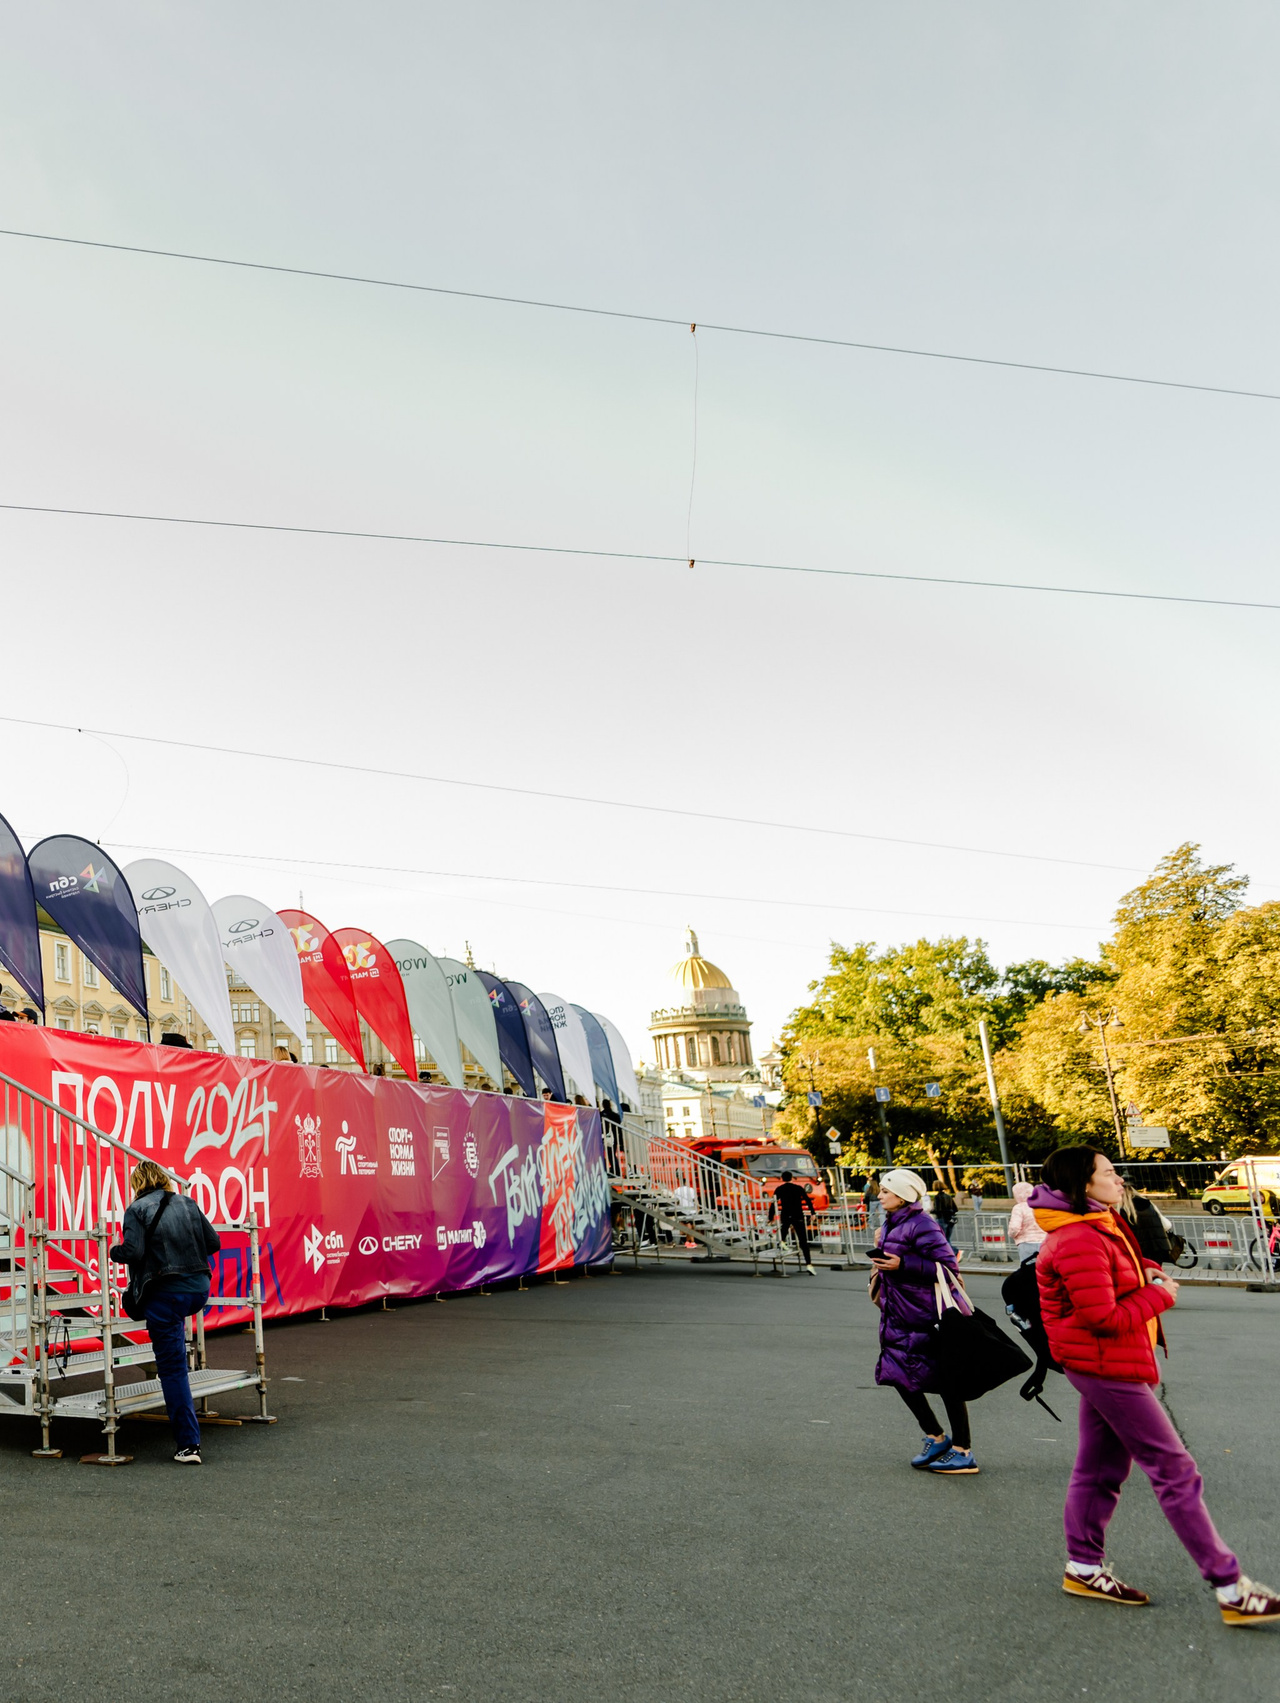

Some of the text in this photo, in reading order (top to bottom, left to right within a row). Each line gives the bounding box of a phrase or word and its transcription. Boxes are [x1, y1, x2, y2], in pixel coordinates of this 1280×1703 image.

[52, 1070, 278, 1165] ПОЛУ 2024
[388, 1127, 408, 1143] СПОРТ
[389, 1144, 414, 1160] НОРМА
[391, 1160, 415, 1176] ЖИЗНИ
[325, 1230, 344, 1250] сбп
[382, 1234, 423, 1252] CHERY
[447, 1229, 473, 1245] МАГНИТ
[1247, 1597, 1269, 1614] N
